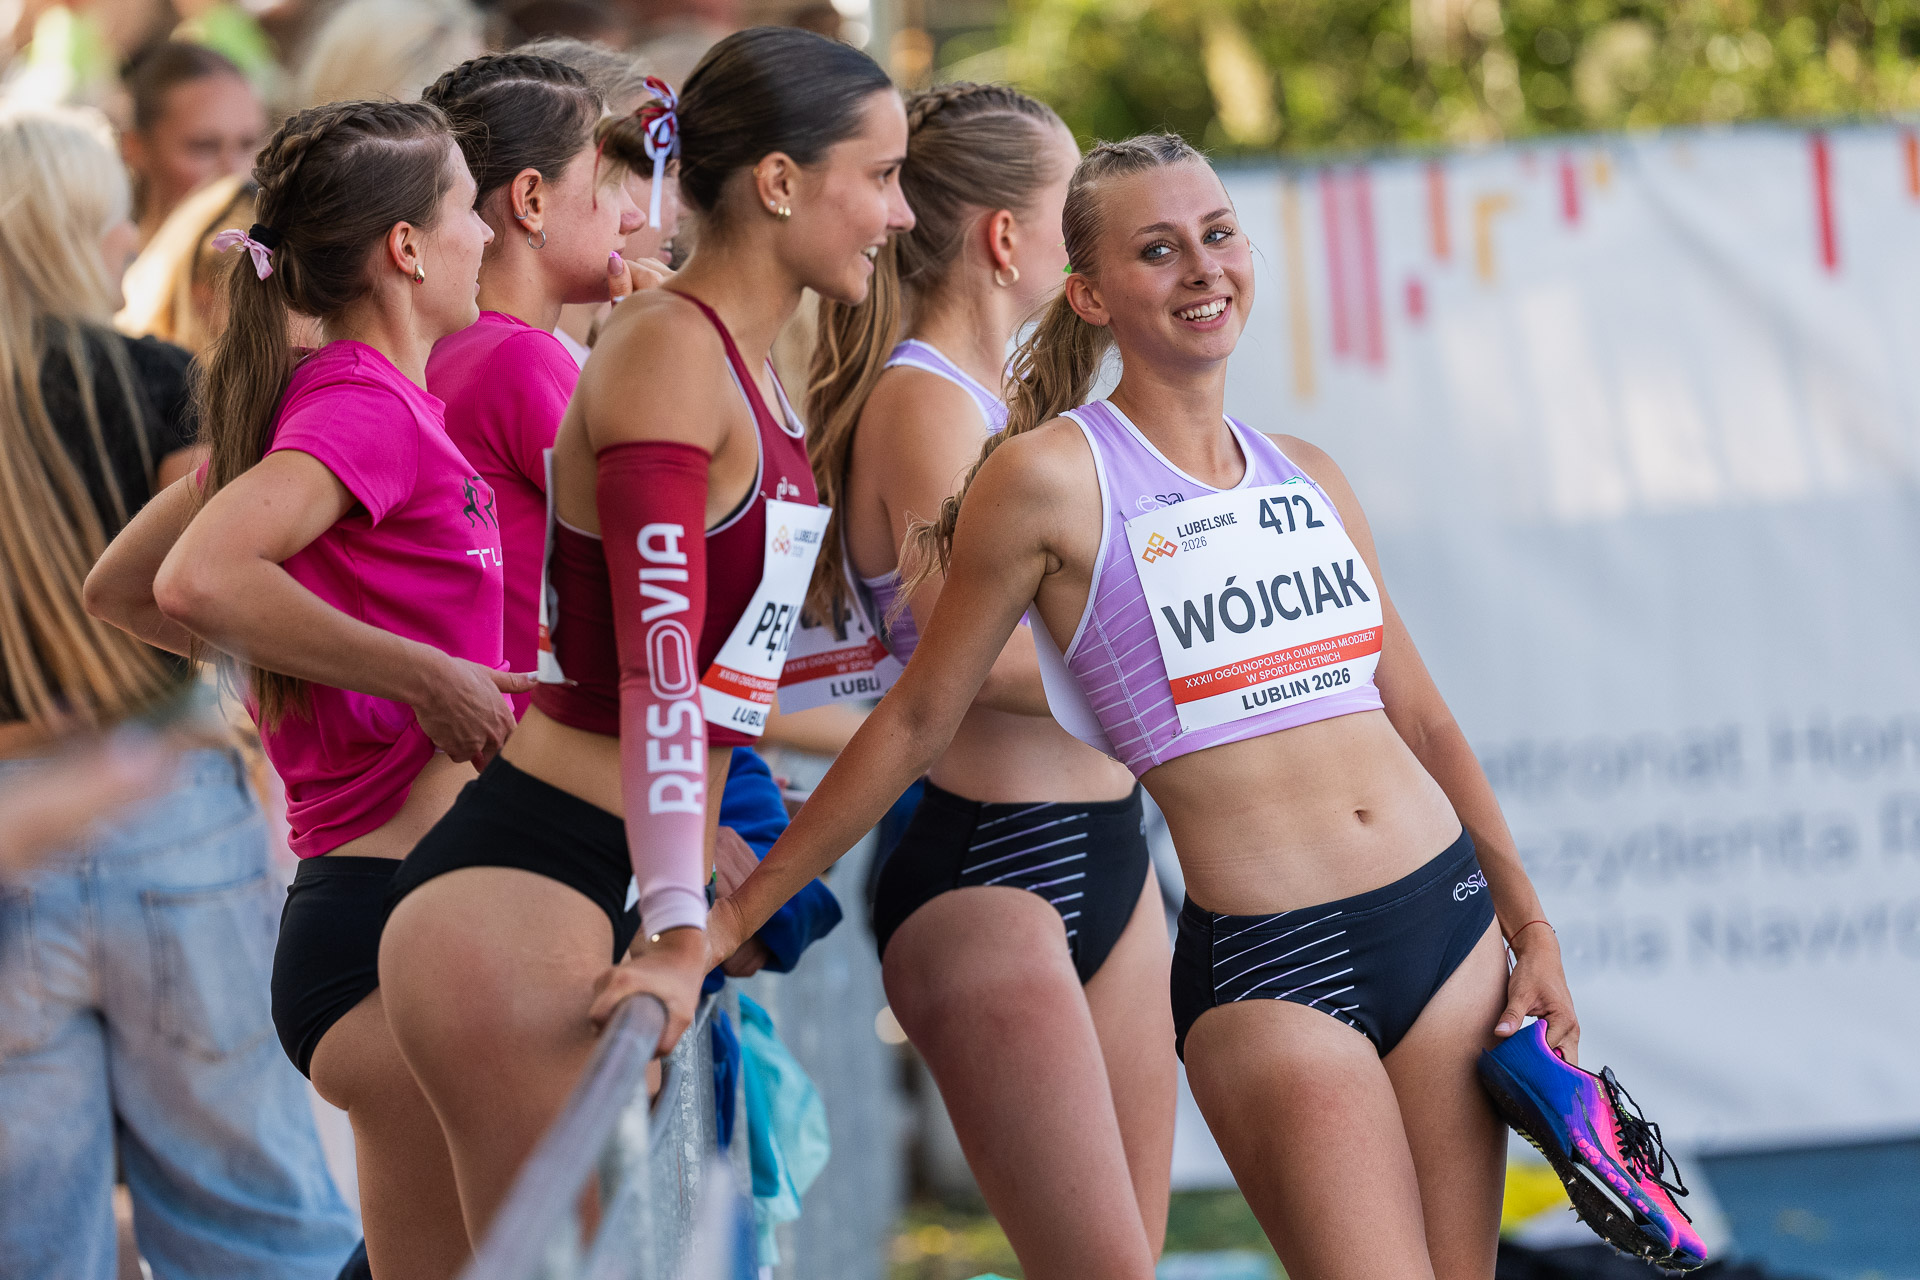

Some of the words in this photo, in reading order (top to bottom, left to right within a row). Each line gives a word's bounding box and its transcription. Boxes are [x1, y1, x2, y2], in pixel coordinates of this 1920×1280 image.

[1176, 512, 1238, 538] LUBELSKIE
[1258, 494, 1325, 534] 472
[1181, 536, 1208, 552] 2026
[1160, 558, 1371, 650] WÓJCIAK
[637, 522, 703, 816] RESOVIA
[1185, 675, 1213, 689] XXXII
[1214, 652, 1292, 681] OGÓLNOPOLSKA
[1293, 641, 1338, 659] OLIMPIADA
[1338, 630, 1377, 648] MŁODZIEŻY
[1246, 673, 1257, 684] W
[1259, 661, 1308, 680] SPORTACH
[1308, 651, 1341, 668] LETNICH
[1241, 678, 1311, 711] LUBLIN
[1312, 667, 1351, 691] 2026
